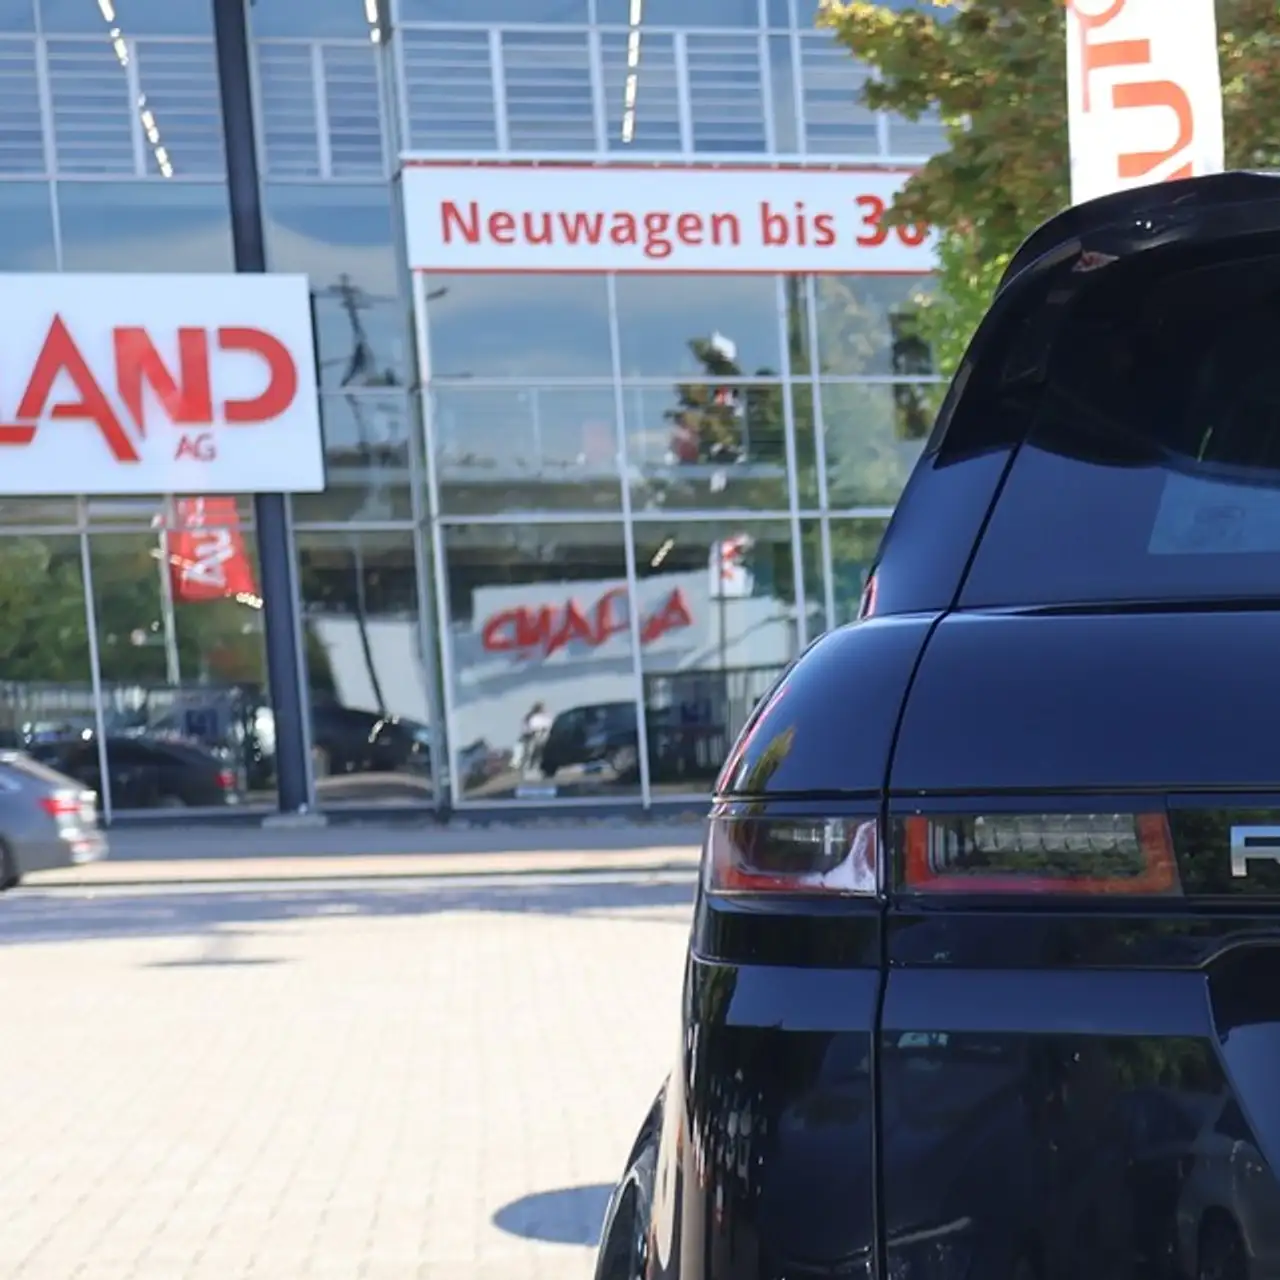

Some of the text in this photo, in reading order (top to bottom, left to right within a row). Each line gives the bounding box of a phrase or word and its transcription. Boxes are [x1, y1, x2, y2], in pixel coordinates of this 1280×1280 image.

[440, 200, 740, 258] Neuwagen
[760, 201, 836, 246] bis
[174, 432, 216, 462] AG
